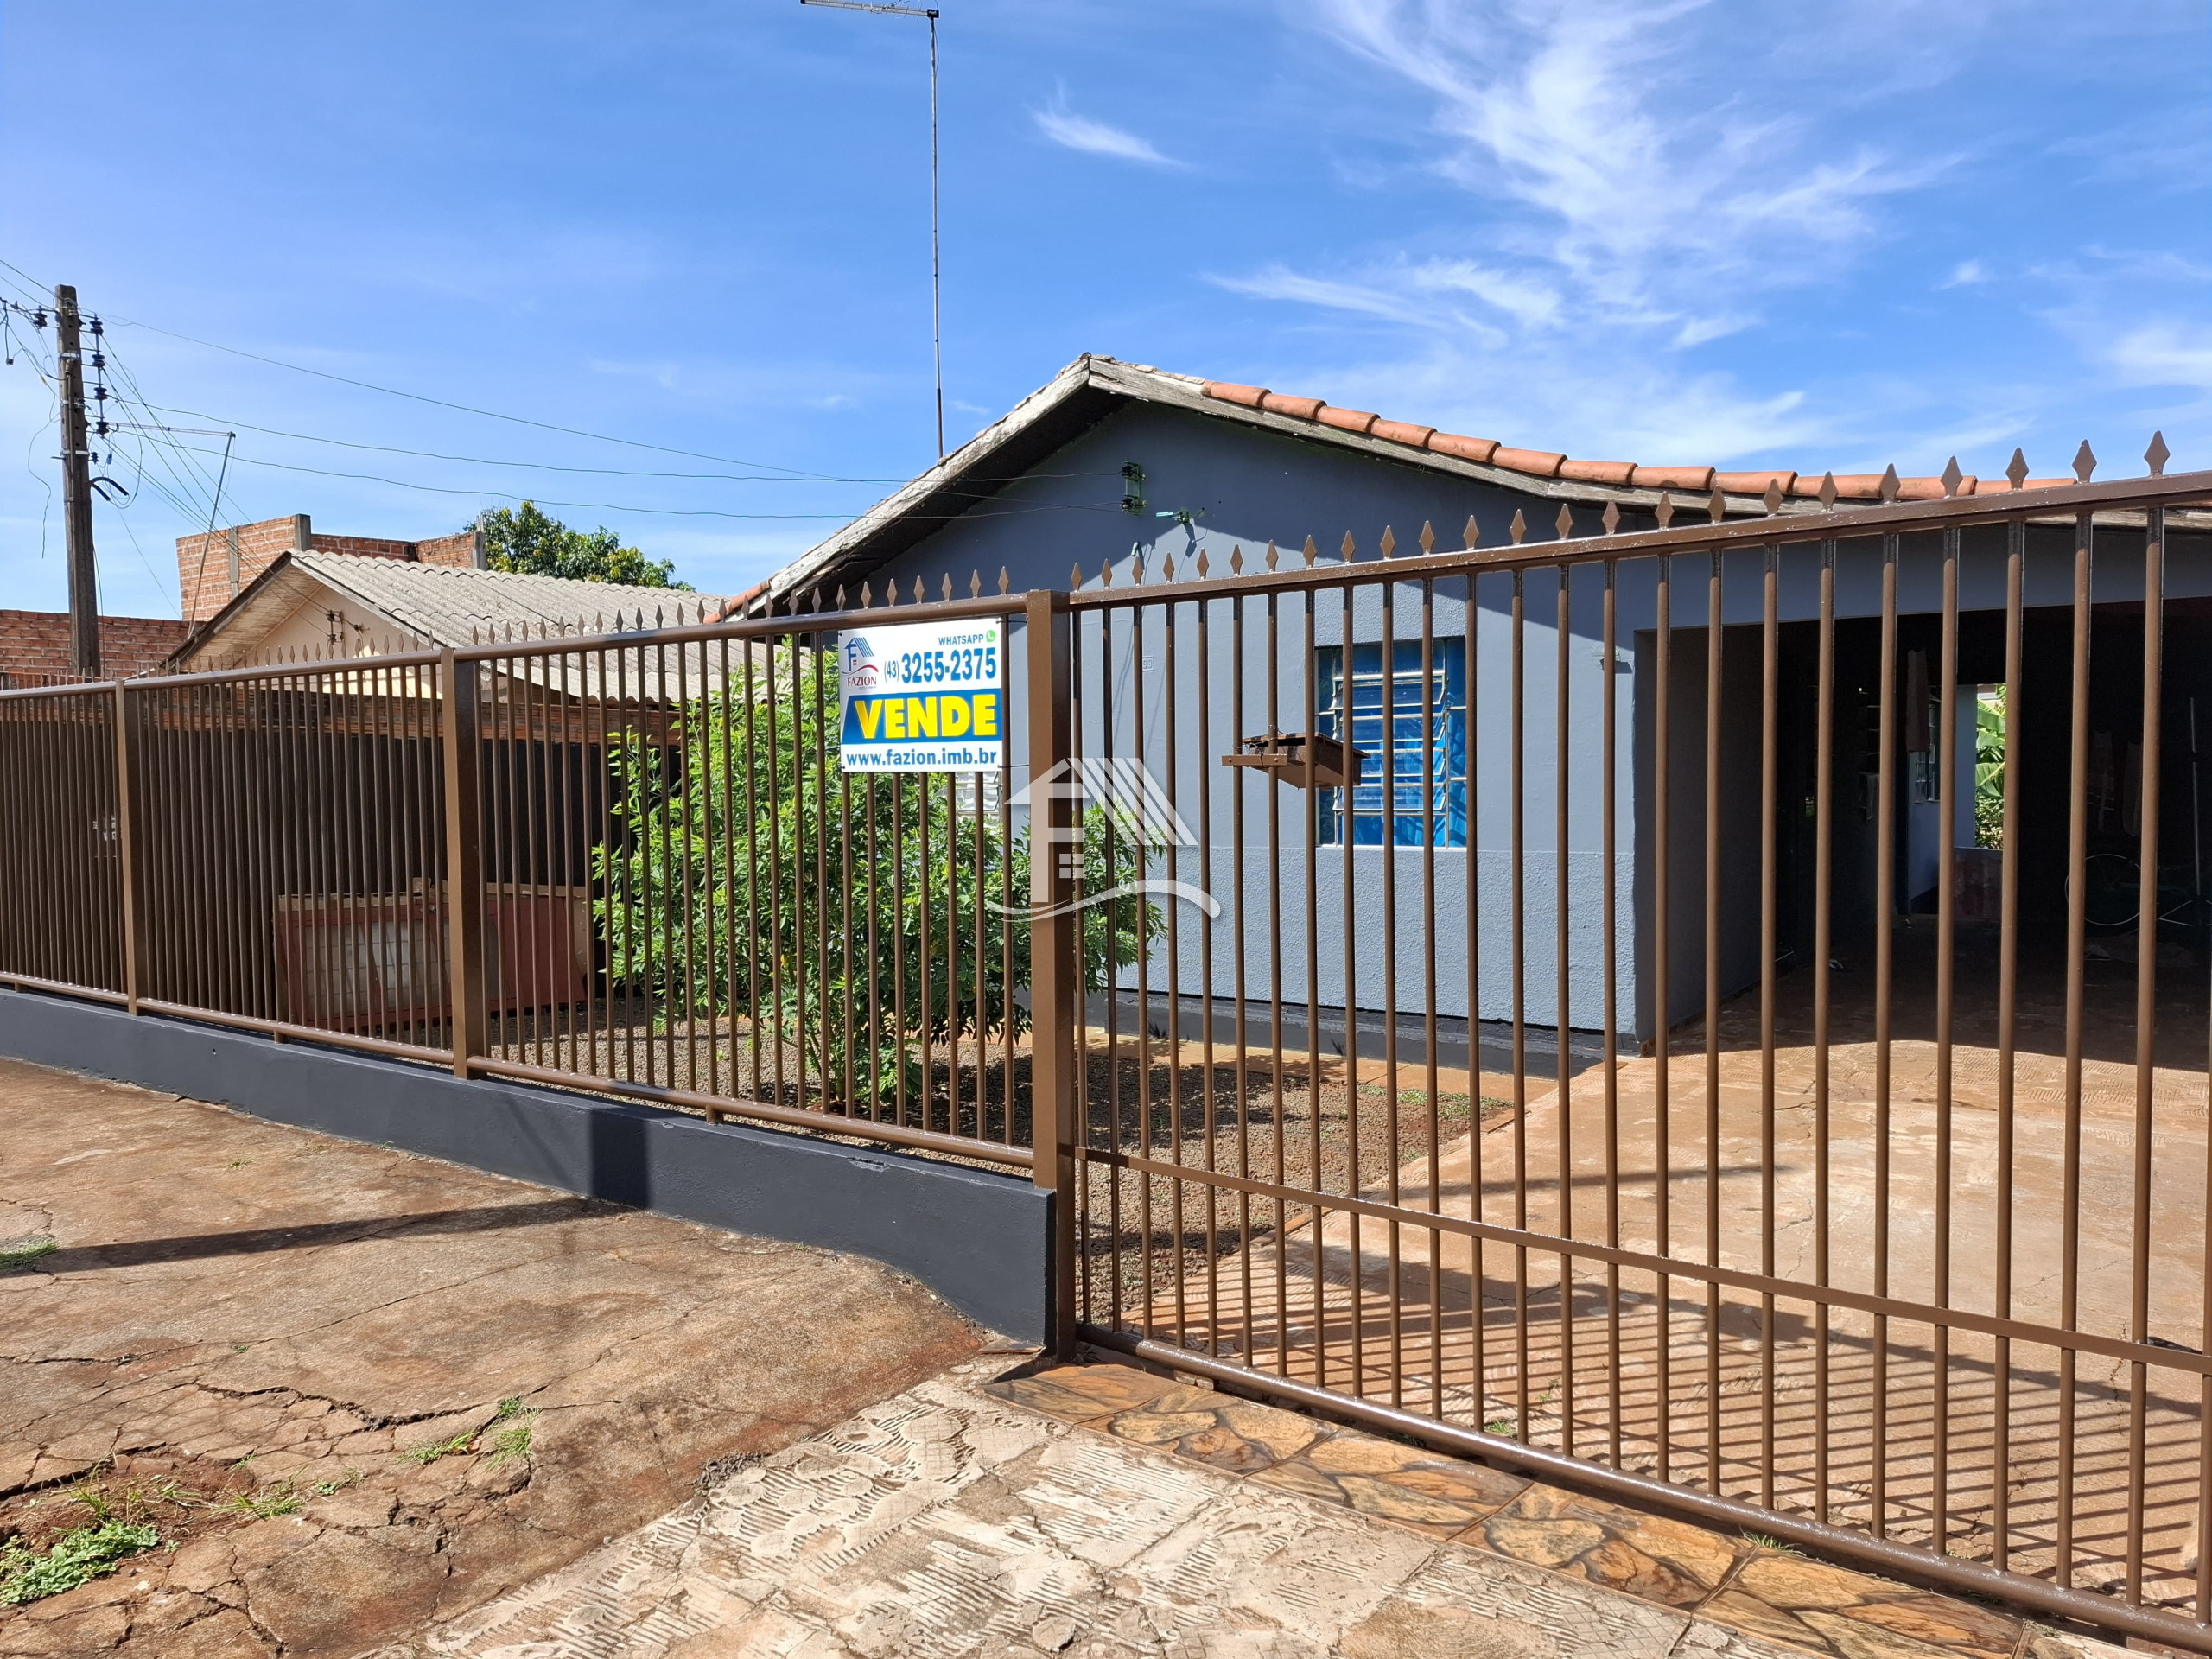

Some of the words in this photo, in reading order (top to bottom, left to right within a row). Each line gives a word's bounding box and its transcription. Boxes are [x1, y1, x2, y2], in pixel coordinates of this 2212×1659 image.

[938, 633, 984, 646] WHATSAPP
[884, 660, 899, 683] (43)
[901, 647, 996, 683] 3255-2375
[847, 676, 877, 687] FAZION
[854, 694, 997, 740] VENDE
[846, 747, 997, 766] www.fazion.imb.br
